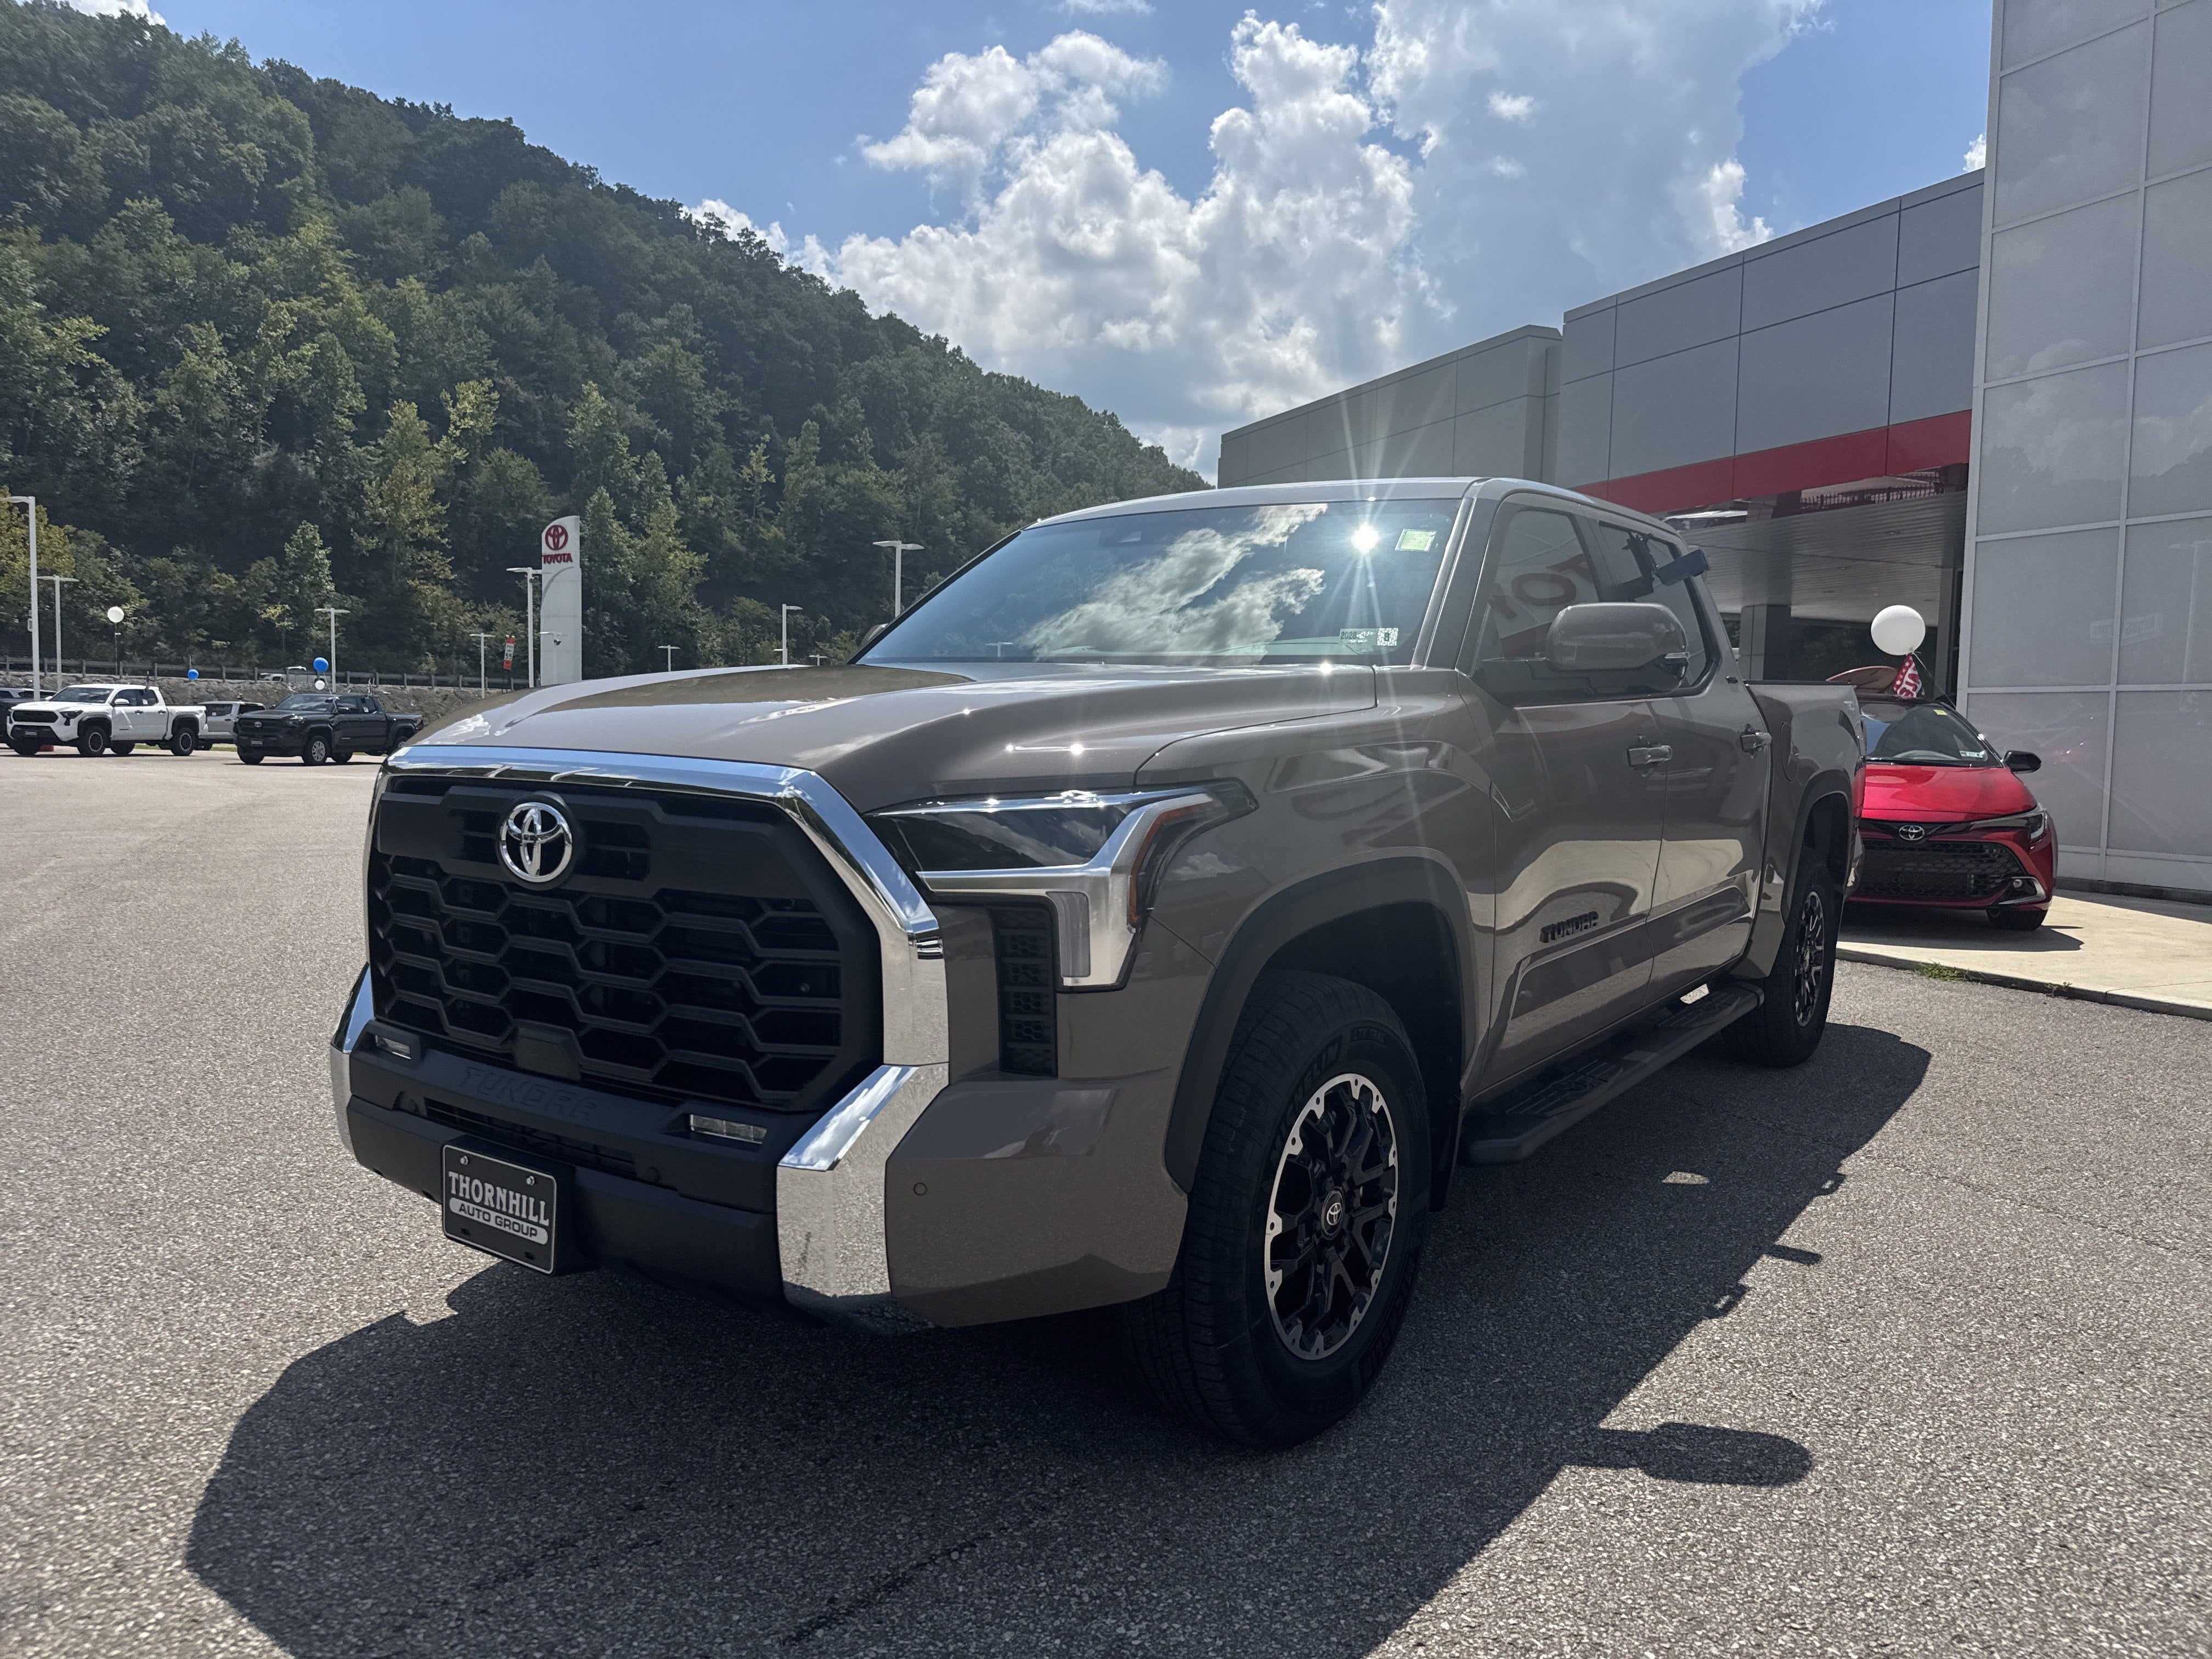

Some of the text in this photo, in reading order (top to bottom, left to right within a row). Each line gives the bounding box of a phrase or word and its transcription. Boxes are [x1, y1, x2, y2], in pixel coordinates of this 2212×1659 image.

[543, 553, 573, 564] TOYOTA
[1340, 631, 1357, 640] 2028
[1539, 911, 1599, 943] TUNDRA
[459, 1066, 602, 1122] TUNDRA
[449, 1171, 549, 1227] THORNHILL
[459, 1203, 538, 1238] AUTO GROUP
